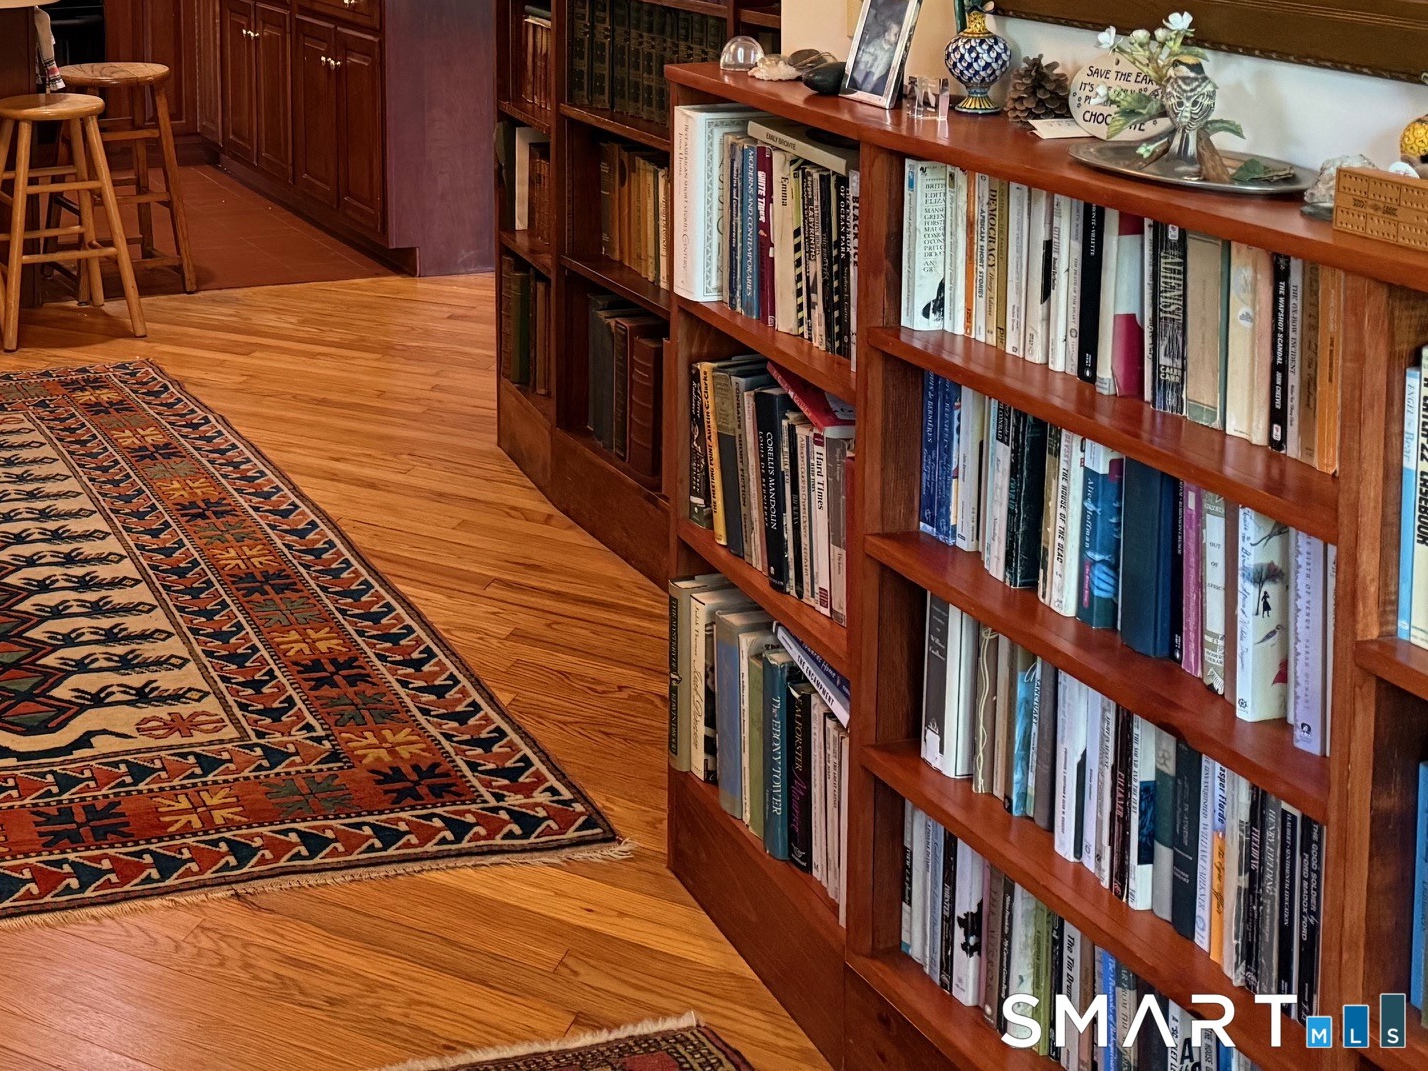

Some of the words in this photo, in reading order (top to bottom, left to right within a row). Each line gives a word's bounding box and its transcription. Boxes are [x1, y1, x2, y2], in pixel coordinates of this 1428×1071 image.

[1079, 82, 1095, 92] IT'S
[1086, 66, 1111, 79] SAVE
[1114, 72, 1133, 82] THE
[766, 133, 779, 143] EMILY
[747, 149, 755, 187] MODERNS
[758, 171, 766, 195] WHITE
[780, 177, 789, 206] Emma
[840, 186, 845, 198] OF
[758, 198, 766, 223] TIGER
[988, 189, 997, 270] DEMOCRACY
[1159, 252, 1184, 322] ALIENIST
[1160, 373, 1181, 382] CARR
[703, 399, 709, 409] C.
[1407, 384, 1415, 415] ENGEL
[1403, 432, 1414, 463] Bear
[816, 451, 825, 477] Hard
[768, 477, 777, 530] MANDOLIN
[817, 480, 825, 510] Times
[1059, 513, 1066, 524] OF
[1305, 584, 1311, 596] OF
[796, 655, 804, 669] THE
[801, 665, 835, 707] ENCAMPMENT
[771, 696, 781, 717] The
[1032, 678, 1041, 726] SANCTUARY
[771, 719, 782, 764] EBONY
[794, 720, 802, 771] FORSTER
[772, 767, 782, 816] TOWER
[1218, 766, 1226, 792] asper
[1217, 794, 1226, 824] Fforde
[1267, 810, 1276, 844] HENRY
[1200, 823, 1209, 863] WILLIAM
[1251, 827, 1260, 872] FIELDING
[1198, 864, 1207, 909] FAULKNER
[1310, 871, 1318, 911] SOLDIER
[1307, 915, 1319, 925] by
[1003, 939, 1009, 947] My
